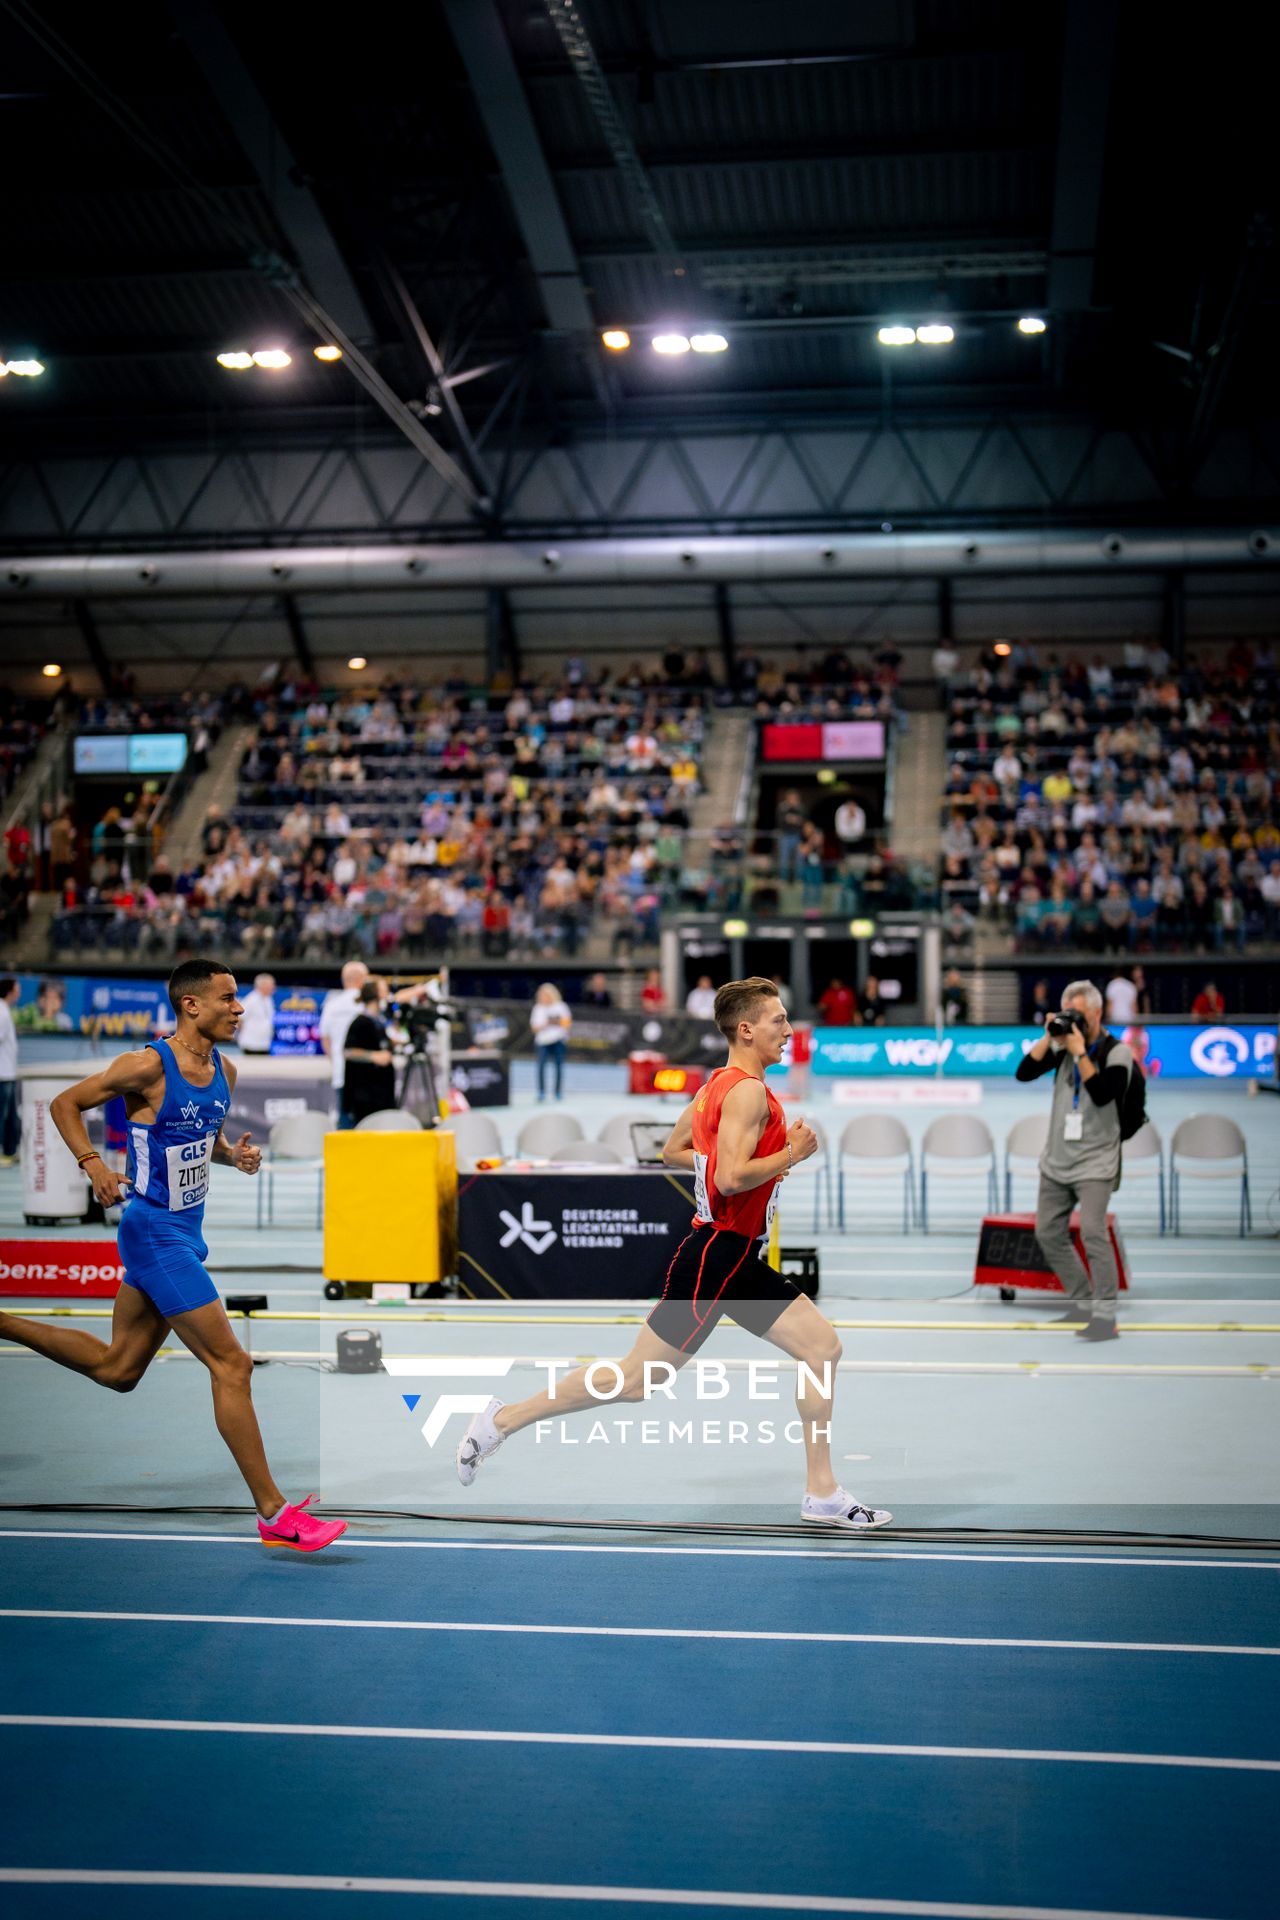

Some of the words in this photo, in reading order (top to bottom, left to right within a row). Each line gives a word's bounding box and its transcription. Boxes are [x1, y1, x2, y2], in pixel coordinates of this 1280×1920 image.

[885, 1038, 953, 1066] WGV
[181, 1142, 207, 1162] GLS
[562, 1209, 639, 1222] DEUTSCHER
[562, 1222, 669, 1235] LEICHTATHLETIK
[562, 1236, 624, 1248] VERBAND
